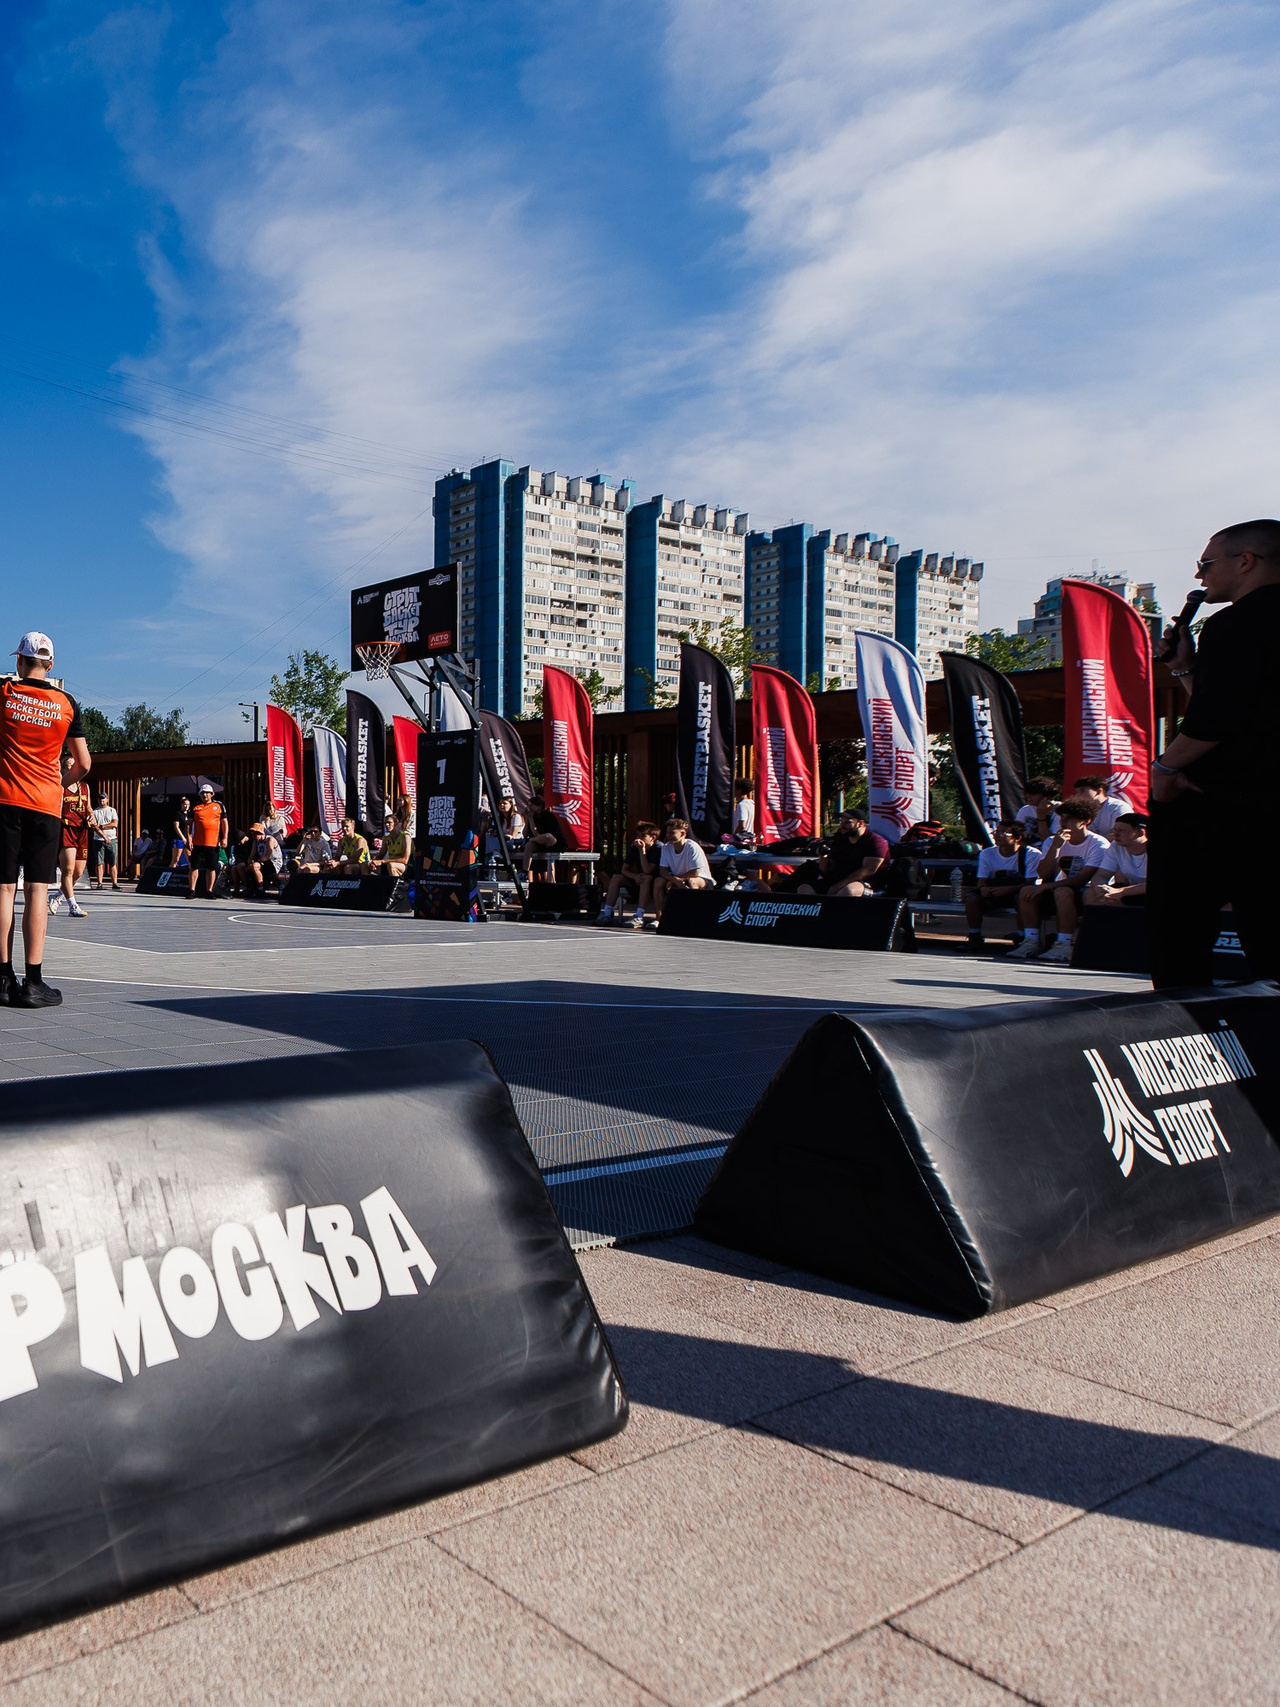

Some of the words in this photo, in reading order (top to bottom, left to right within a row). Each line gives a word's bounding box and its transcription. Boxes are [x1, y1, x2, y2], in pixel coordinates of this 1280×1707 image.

[383, 602, 422, 627] БАСКЕТ
[384, 586, 420, 611] СТРИТ
[384, 617, 419, 637] ТУР
[5, 700, 62, 720] БАСКЕТБОЛА
[12, 711, 52, 728] МОСКВЫ
[1076, 658, 1107, 764] МОСКОВСКИЙ
[550, 720, 568, 794] МОСКОВСКИЙ
[692, 681, 713, 822] STREETBASKET
[868, 697, 893, 790] МОСКОВСКИЙ
[1108, 715, 1133, 766] СПОРТ
[271, 746, 285, 801] МОСКОВСКИЙ
[357, 718, 369, 822] STREETBASKET
[436, 758, 447, 785] 1
[568, 760, 583, 796] СПОРТ
[894, 747, 915, 791] СПОРТ
[285, 776, 295, 802] СПОРТ
[320, 766, 336, 824] МОСКОВСКИЙ
[785, 773, 804, 814] СПОРТ
[428, 819, 455, 829] ТУР
[322, 888, 340, 898] СПОРТ
[325, 879, 361, 889] МОСКОВСКИЙ
[744, 914, 779, 927] СПОРТ
[748, 901, 822, 917] МОСКОВСКИЙ
[1119, 1019, 1257, 1098] МОСКОВСКИЙ
[1153, 1099, 1232, 1166] СПОРТ
[73, 1185, 438, 1384] МОСКВА
